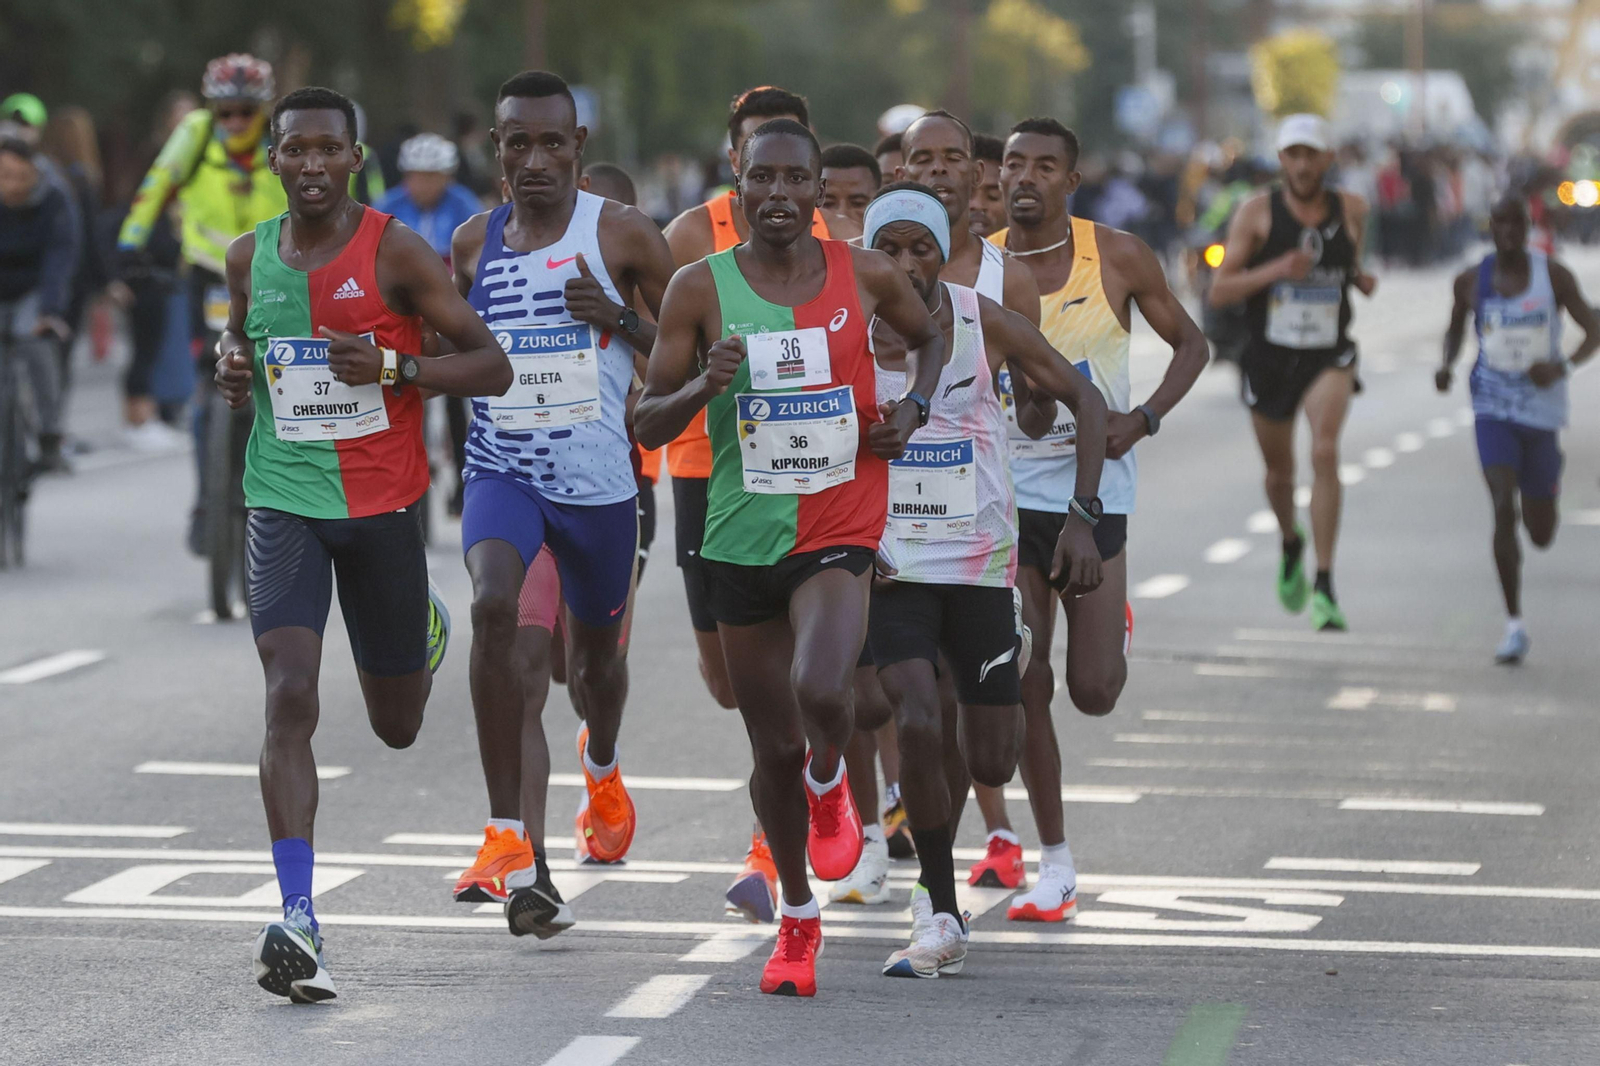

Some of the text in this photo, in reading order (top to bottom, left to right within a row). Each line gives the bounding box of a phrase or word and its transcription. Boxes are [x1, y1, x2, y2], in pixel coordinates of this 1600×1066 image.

[333, 289, 365, 300] adidas
[518, 333, 578, 348] ZURICH
[302, 347, 330, 360] ZU
[780, 337, 801, 360] 36
[520, 372, 562, 386] GELETA
[314, 382, 331, 396] 37
[537, 394, 546, 404] 6
[293, 402, 360, 417] CHERUIYOT
[778, 400, 840, 416] ZURICH
[790, 436, 808, 449] 36
[902, 448, 962, 463] ZURICH
[772, 456, 830, 470] KIPKORIR
[915, 482, 922, 495] 1
[892, 502, 948, 516] BIRHANU
